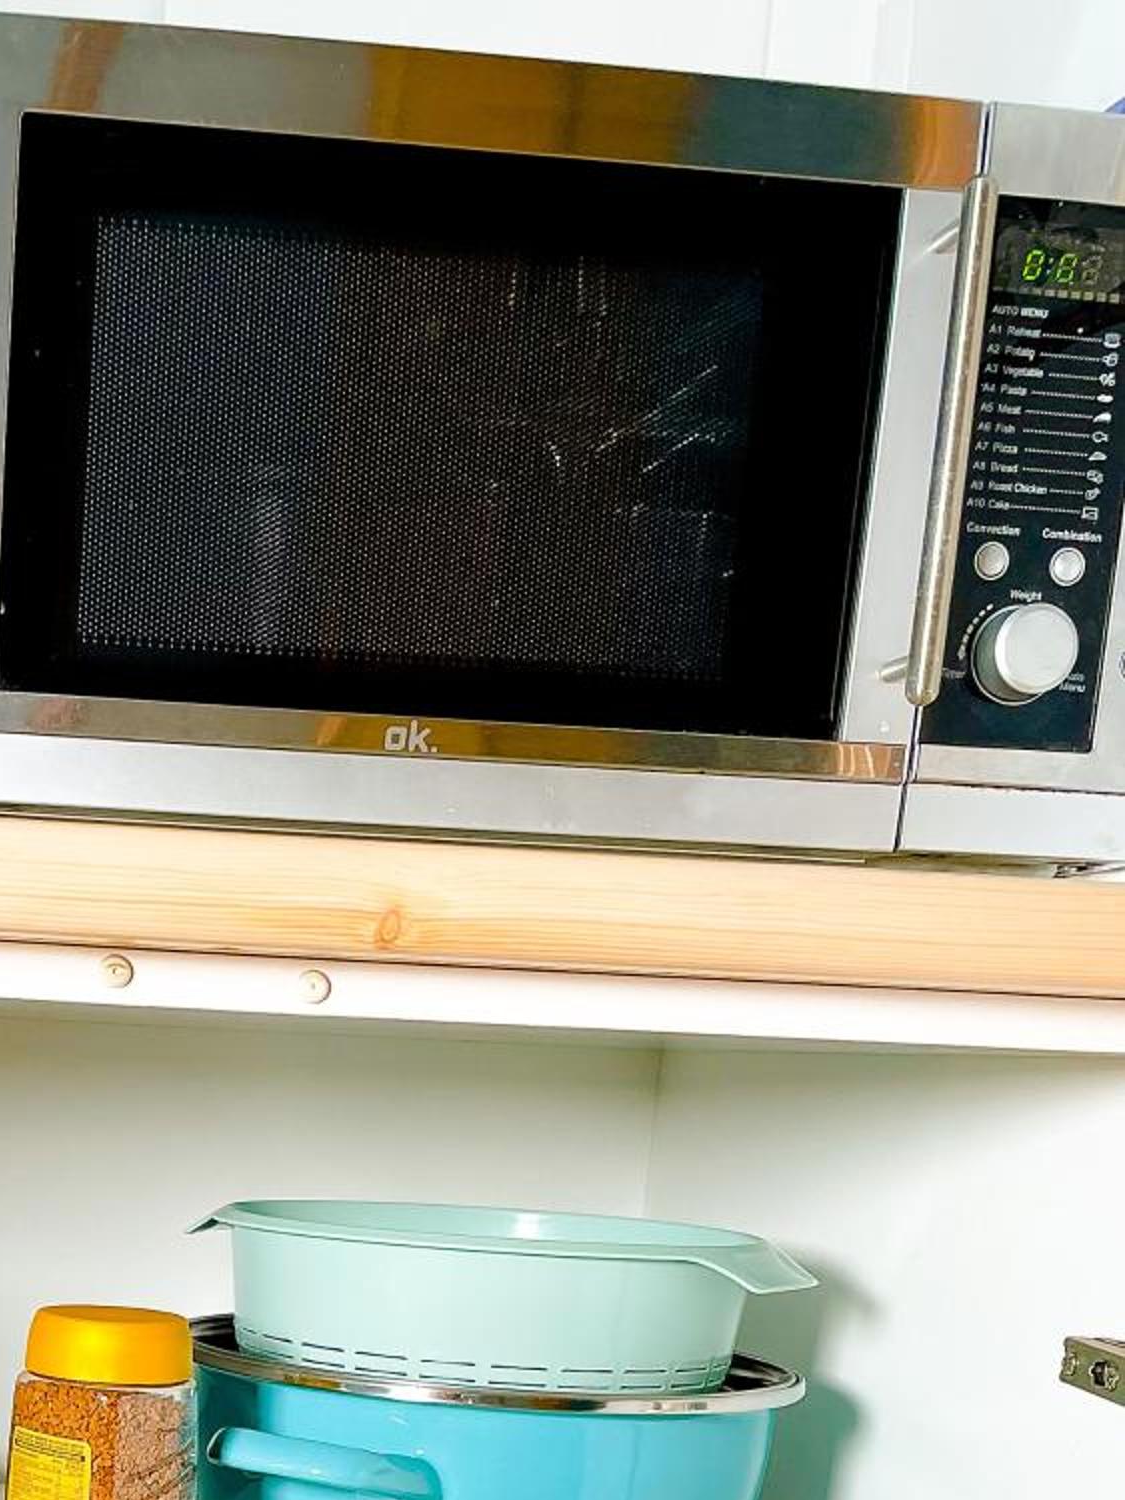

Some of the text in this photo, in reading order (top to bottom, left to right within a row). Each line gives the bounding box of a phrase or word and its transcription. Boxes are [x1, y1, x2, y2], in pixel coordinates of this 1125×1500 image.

[992, 305, 1019, 316] AUTO
[988, 323, 1002, 334] A1
[966, 522, 1022, 536] Convection
[1042, 528, 1103, 543] Combination
[1010, 589, 1043, 603] Weight
